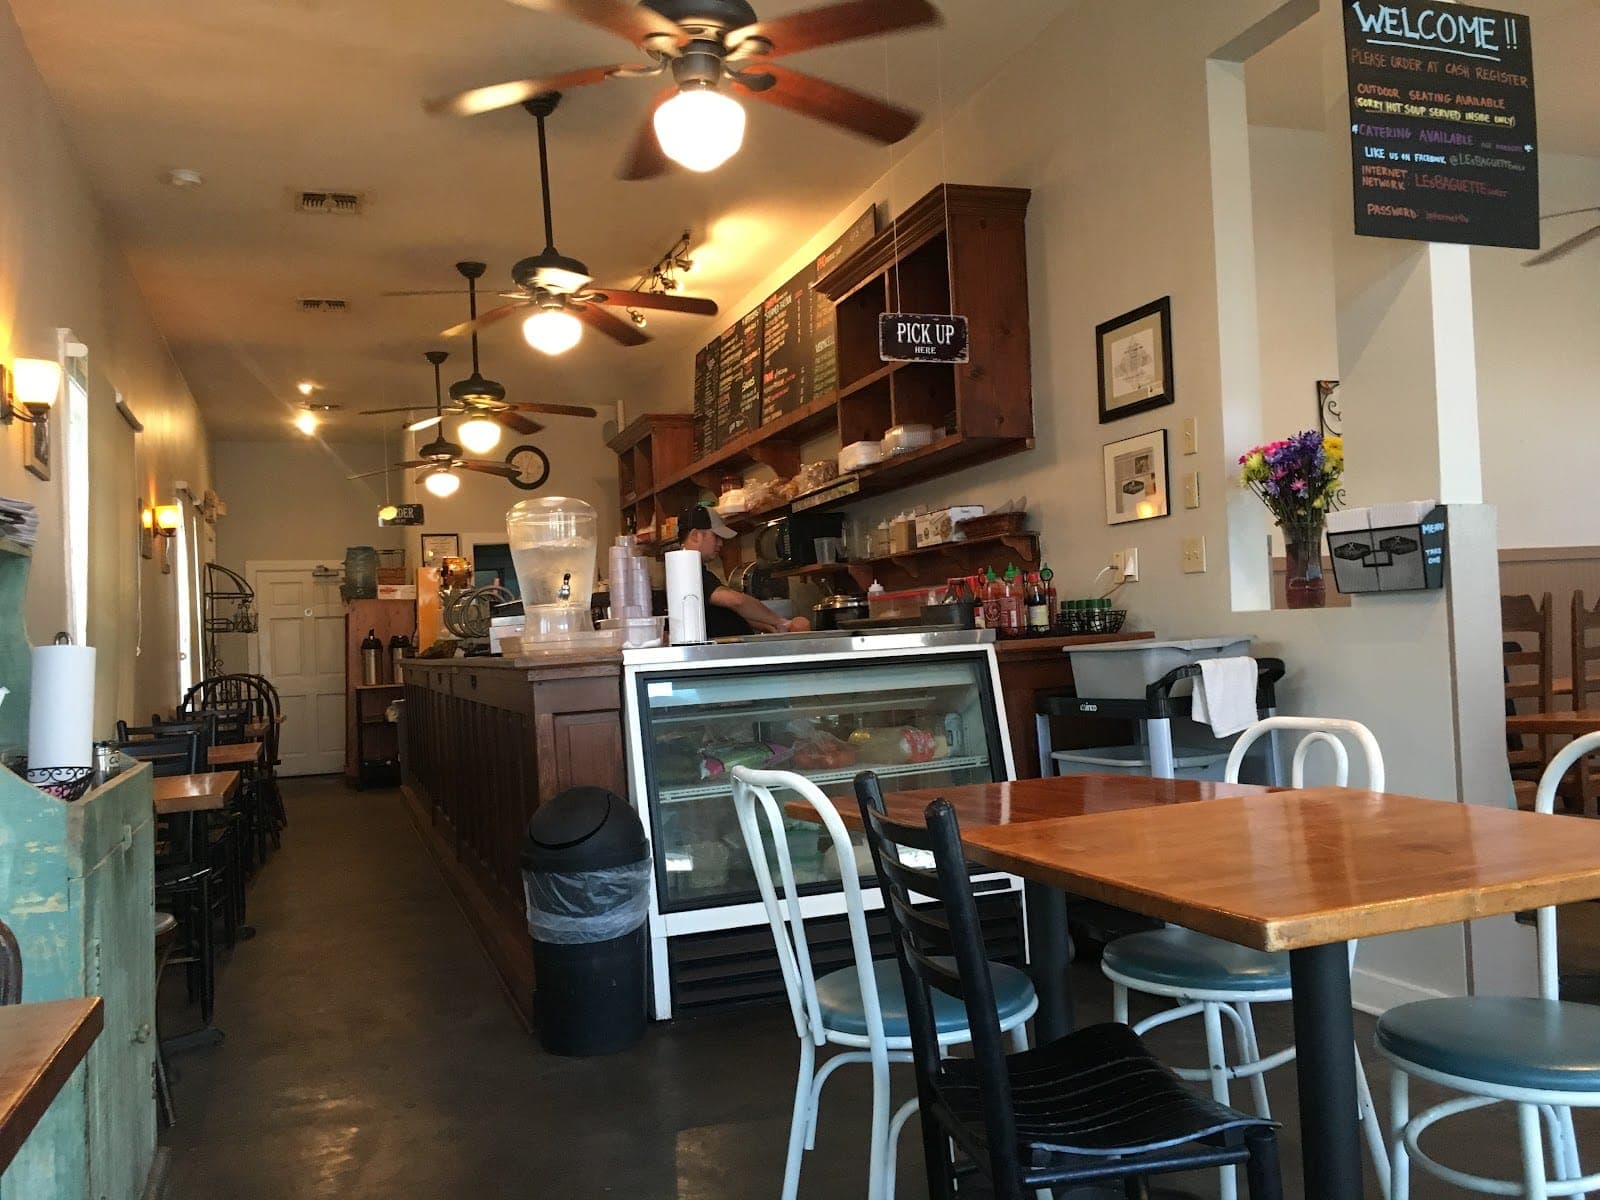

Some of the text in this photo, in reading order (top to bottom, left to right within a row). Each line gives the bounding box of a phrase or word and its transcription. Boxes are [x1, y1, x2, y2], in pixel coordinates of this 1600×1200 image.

[1352, 1, 1499, 50] WELCOME
[1351, 51, 1529, 88] PLEASE ORDER AT CASH REGISTER
[1356, 83, 1505, 109] OUTDOOR SEATING AVAILABLE
[1386, 100, 1403, 113] HOT
[1404, 104, 1425, 116] SOUP
[1429, 107, 1461, 121] SERVED
[1359, 123, 1474, 146] CATERING AVAILABLE
[1364, 146, 1385, 159] LIKE
[1389, 152, 1399, 161] US
[1361, 165, 1408, 179] INTERNET
[1361, 176, 1407, 191] NETWORK
[1367, 203, 1418, 220] PASSWORD
[897, 322, 955, 345] PICK UP
[914, 346, 936, 354] HERE
[1421, 522, 1444, 535] MENU
